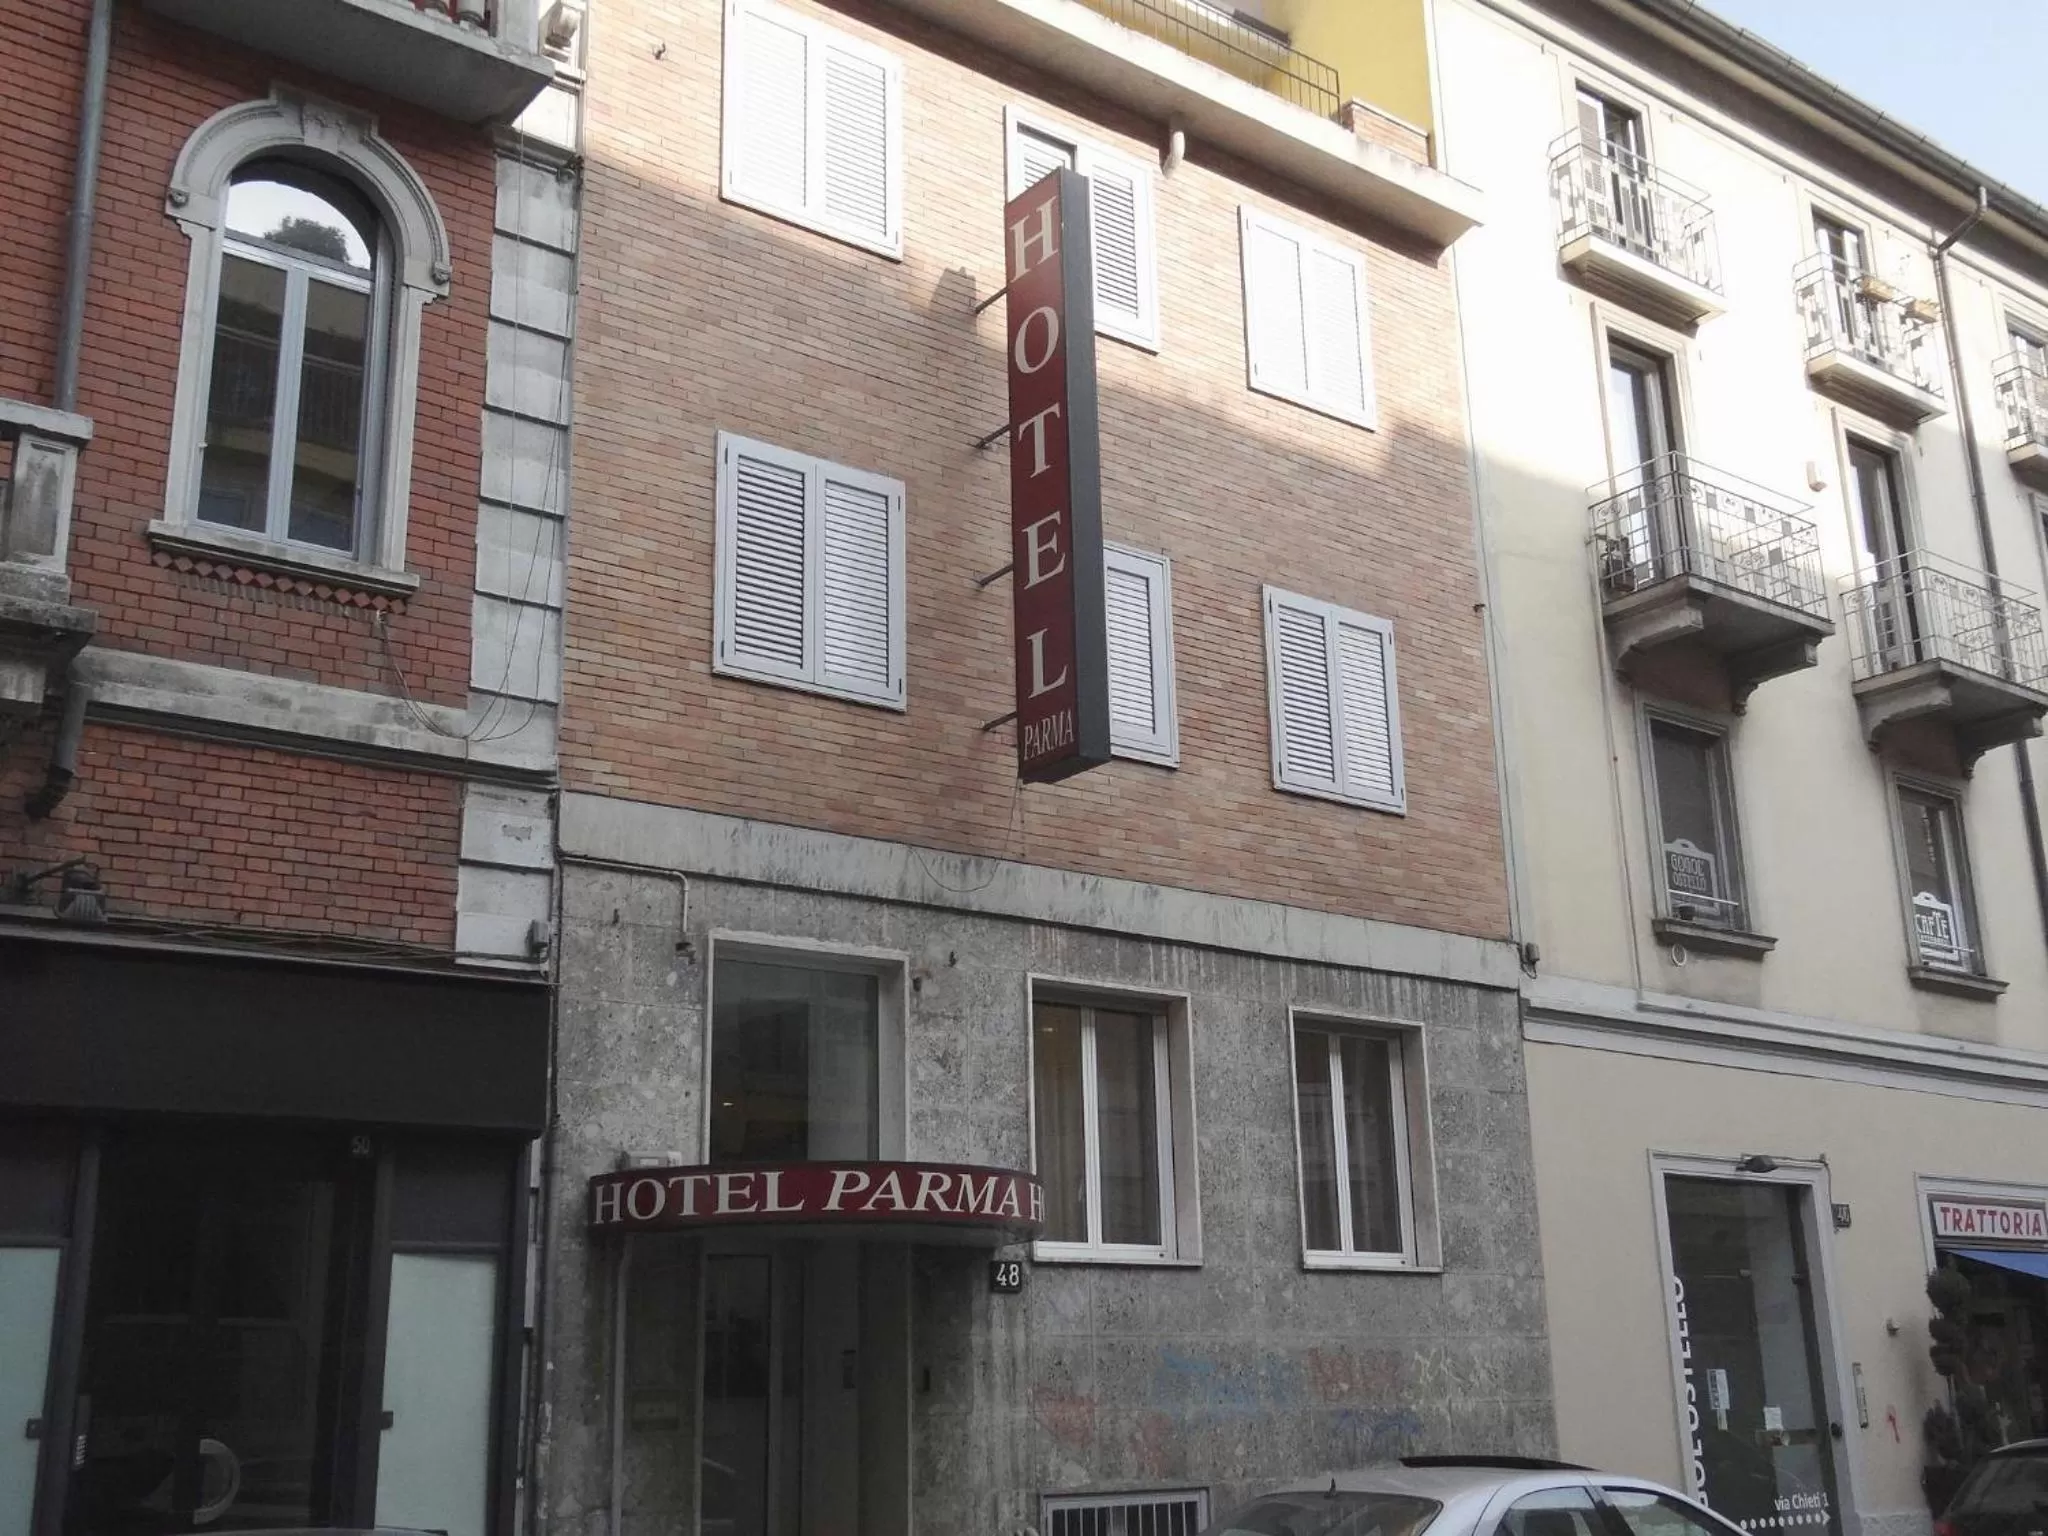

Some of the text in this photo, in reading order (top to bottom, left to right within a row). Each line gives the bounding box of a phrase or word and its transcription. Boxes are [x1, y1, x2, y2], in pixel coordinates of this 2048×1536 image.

[1009, 196, 1068, 699] HOTEL
[1024, 709, 1074, 760] PARMA
[592, 1171, 805, 1224] HOTEL
[821, 1169, 1023, 1217] PARMA
[1940, 1206, 2042, 1236] TRATTORIA
[996, 1263, 1020, 1286] 48
[1775, 1496, 1790, 1511] via
[1792, 1492, 1820, 1509] Chieti
